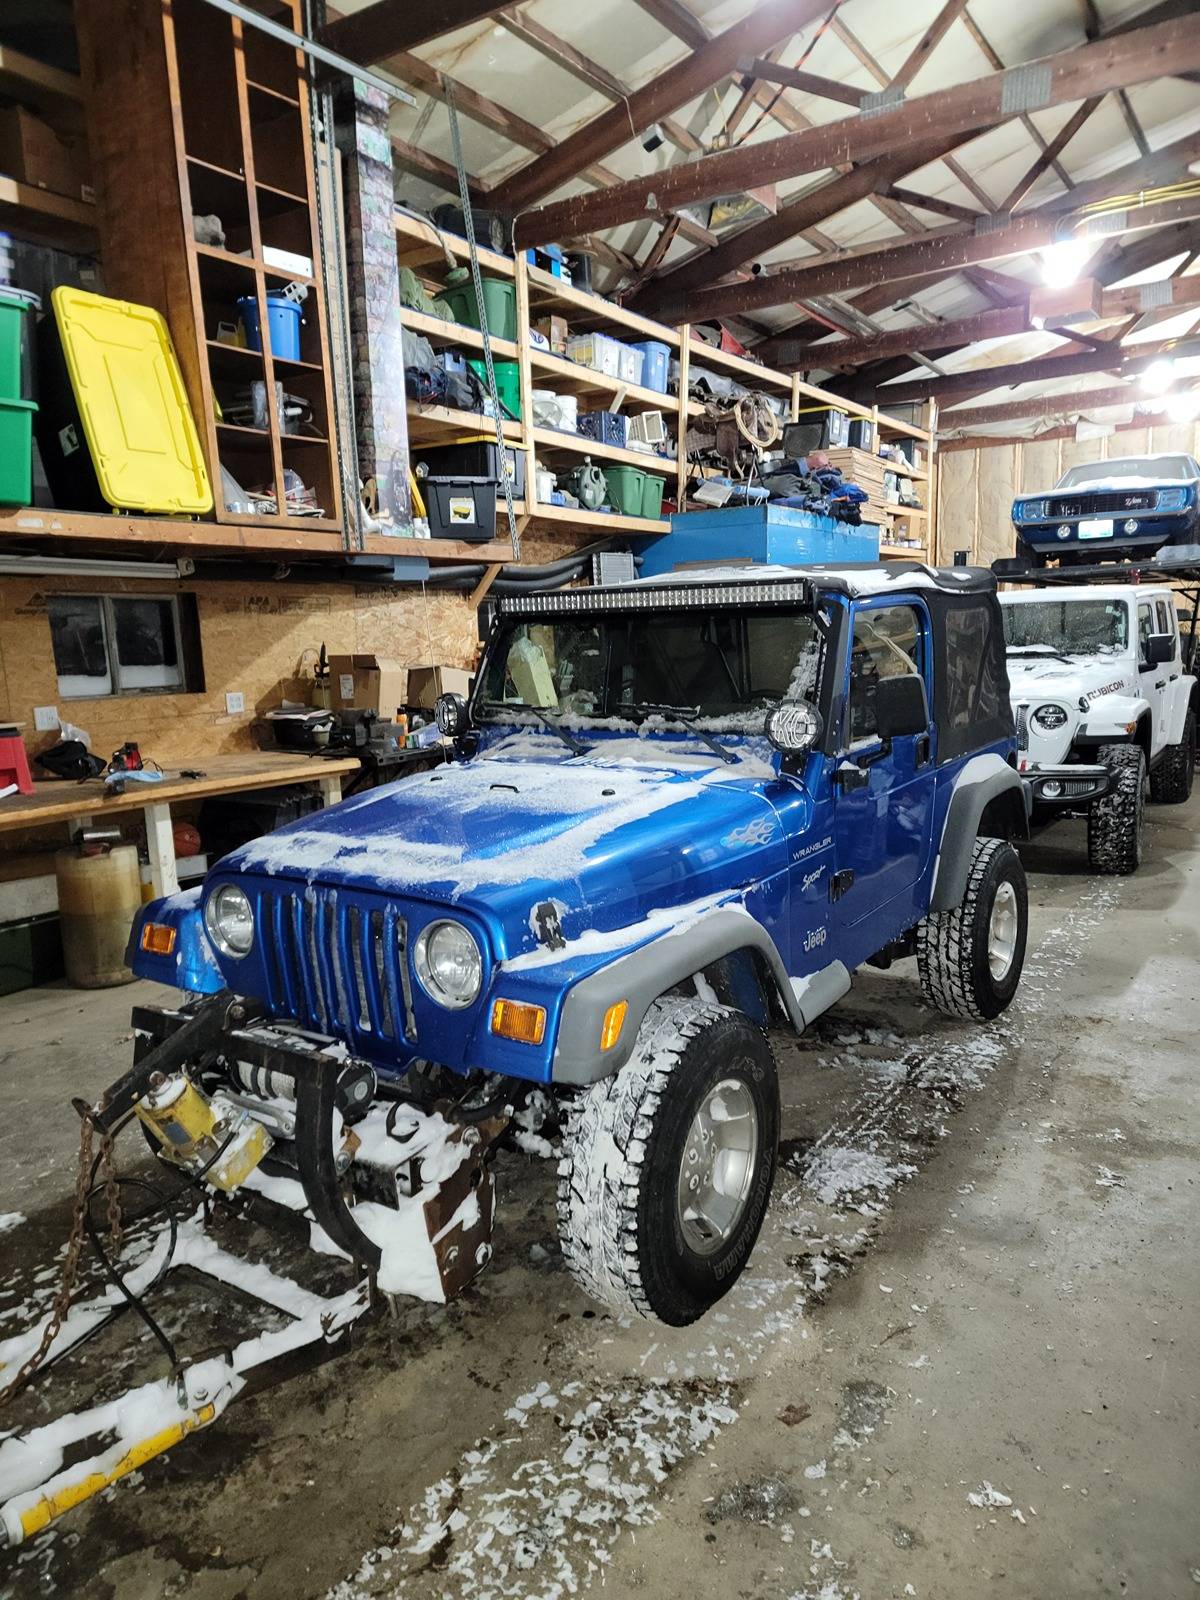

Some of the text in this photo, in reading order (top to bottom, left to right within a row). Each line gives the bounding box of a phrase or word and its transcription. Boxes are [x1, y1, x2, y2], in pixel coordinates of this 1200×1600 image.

[1086, 680, 1125, 701] RUBICON
[771, 708, 812, 749] KC
[792, 836, 832, 860] WRANGLER
[803, 926, 827, 952] Jeep
